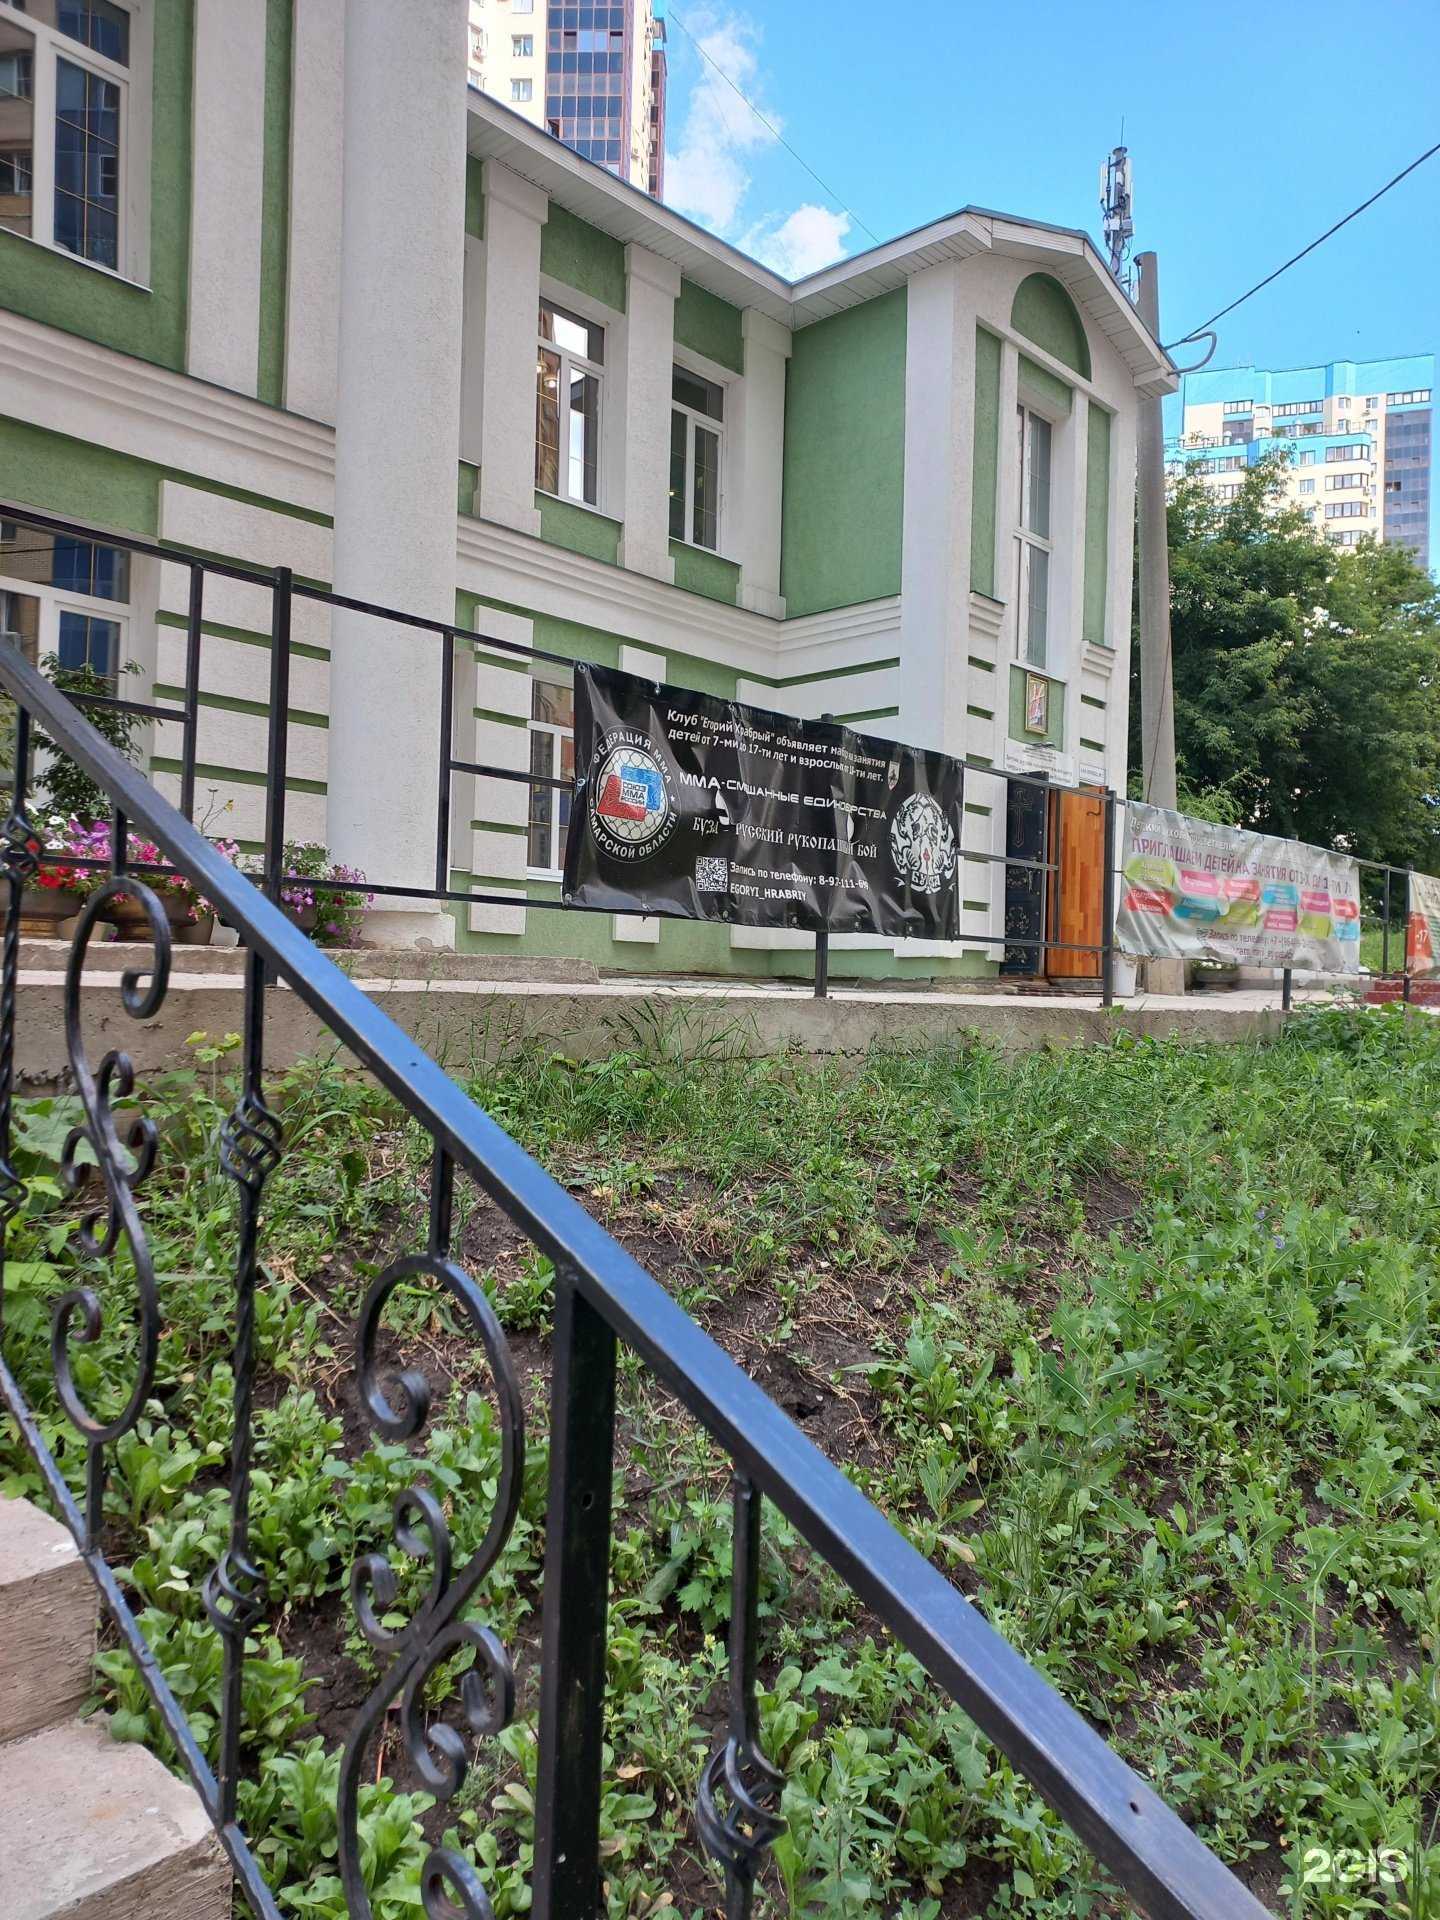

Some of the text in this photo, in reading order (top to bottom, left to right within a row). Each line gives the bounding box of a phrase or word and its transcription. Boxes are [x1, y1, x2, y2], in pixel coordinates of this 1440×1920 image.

[667, 709, 699, 727] Клуб
[700, 715, 733, 734] "Егорий
[734, 722, 775, 743] Храбрый"
[776, 736, 828, 754] объявляет
[593, 731, 672, 783] ФЕДЕРАЦИЯ ММА
[668, 729, 702, 743] детей
[701, 735, 711, 745] от
[713, 735, 738, 748] 7-ми
[749, 743, 771, 758] 17-ти
[773, 751, 788, 762] лет
[790, 755, 797, 763] и
[867, 772, 884, 782] лет.
[622, 788, 645, 800] ММА
[638, 811, 678, 857] ОБЛАСТИ
[730, 862, 756, 876] Запись
[757, 869, 768, 879] по
[770, 871, 817, 886] телефону:
[1204, 853, 1234, 873] ДЕТЕЙ
[730, 883, 807, 901] EGORYI_HRABRIY
